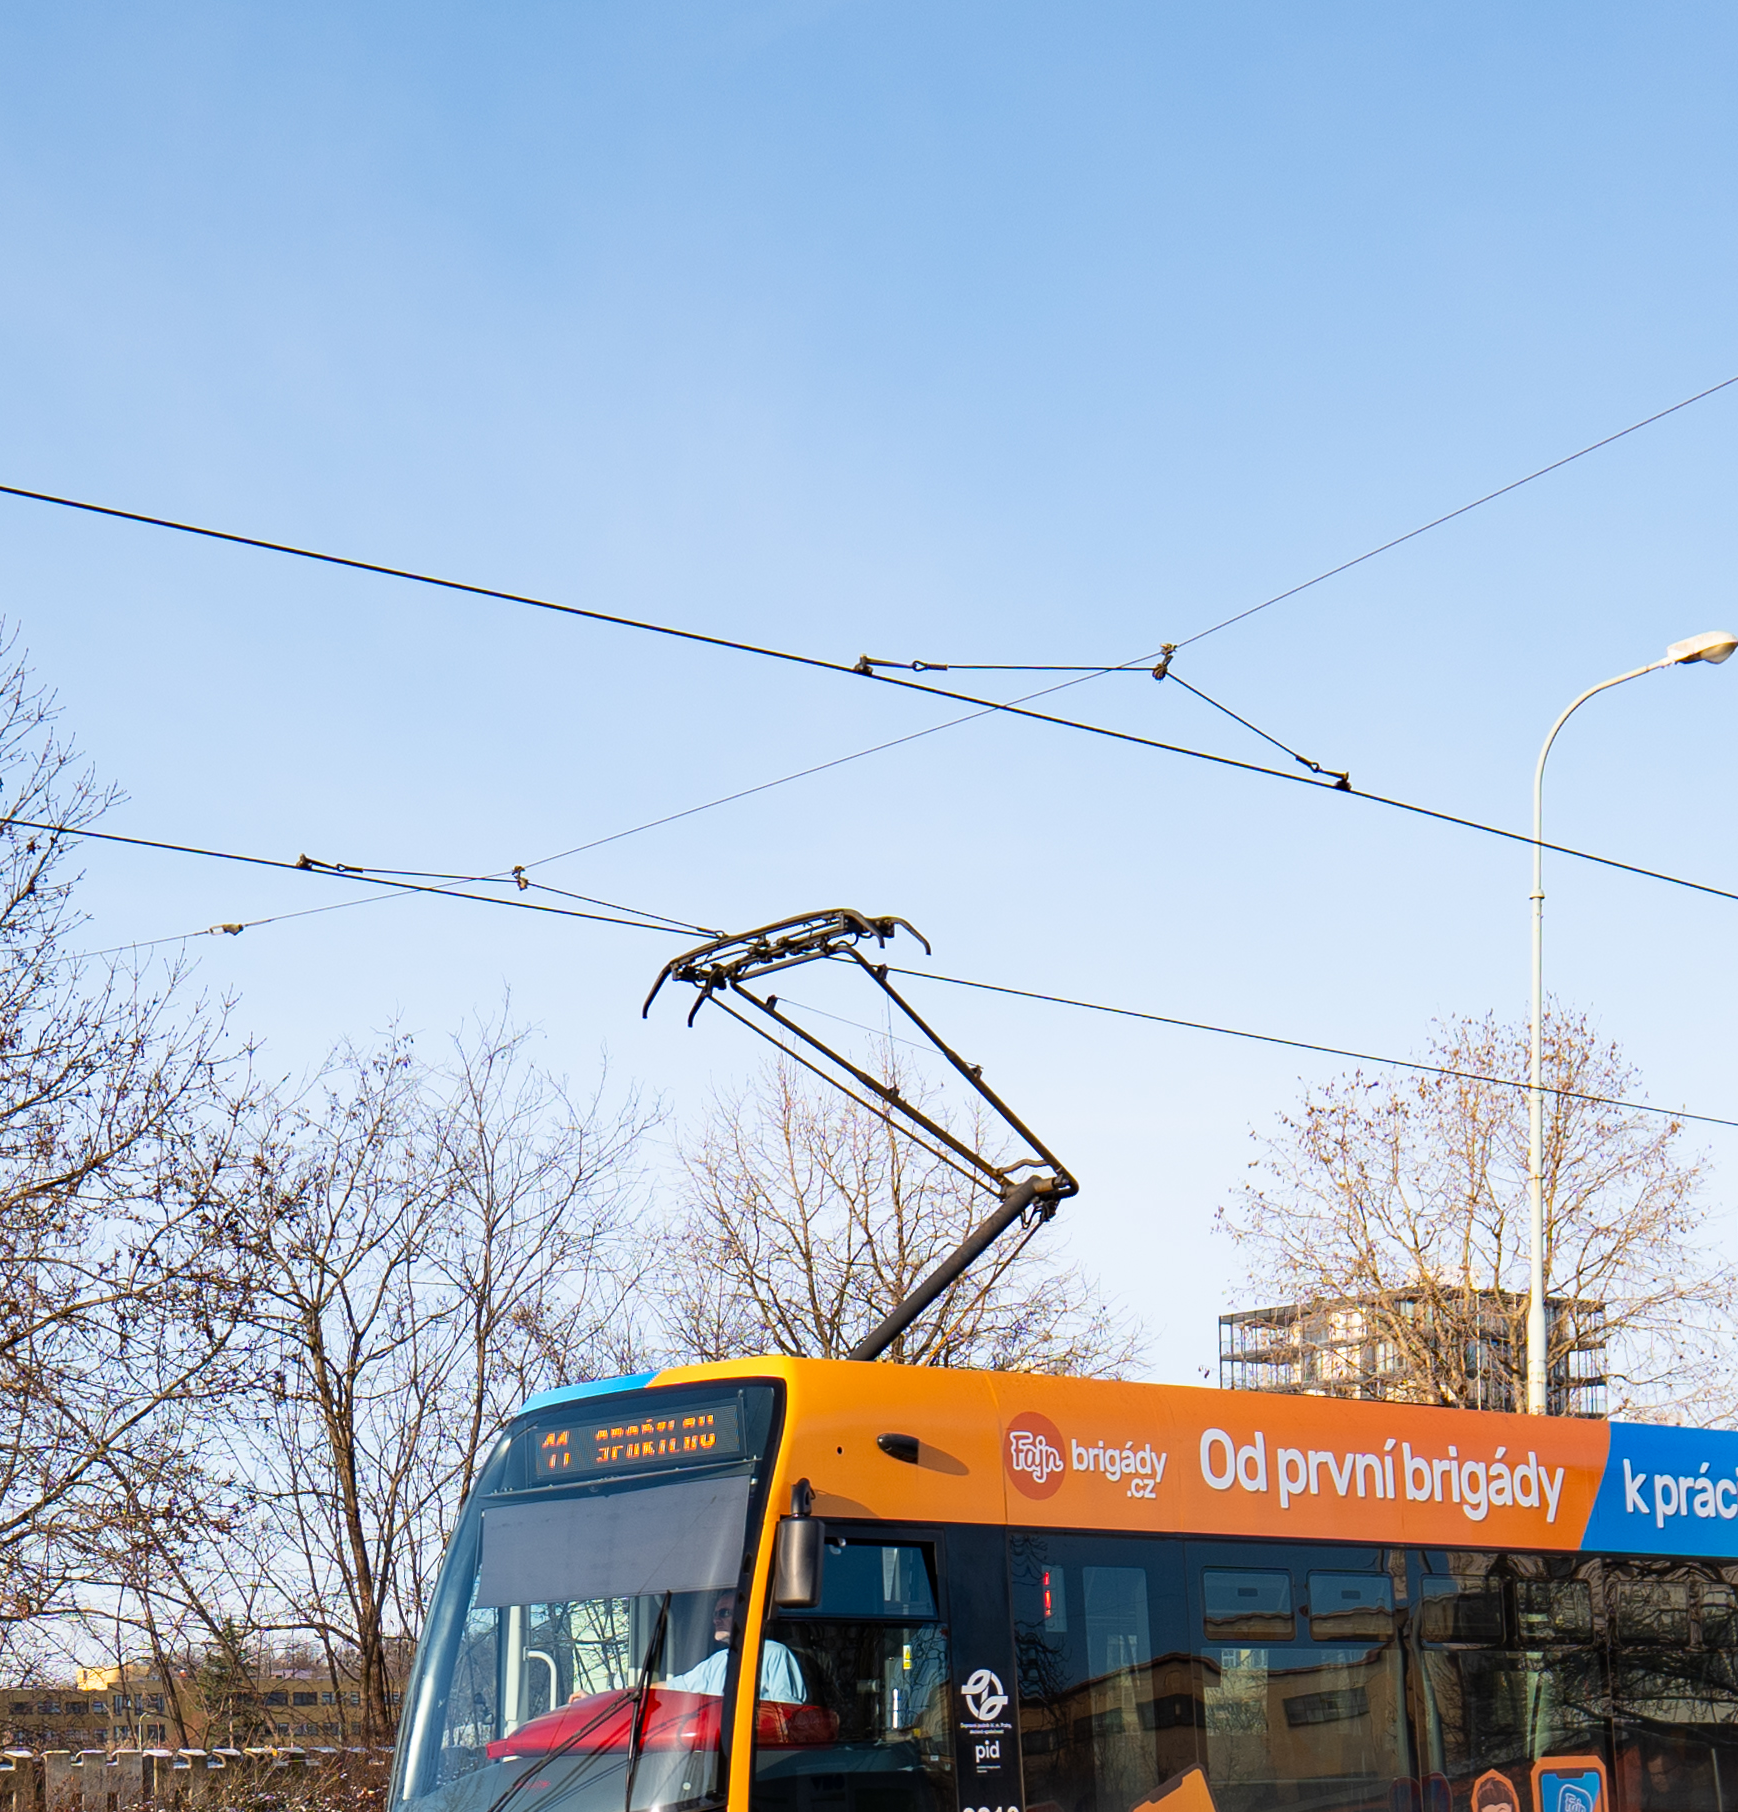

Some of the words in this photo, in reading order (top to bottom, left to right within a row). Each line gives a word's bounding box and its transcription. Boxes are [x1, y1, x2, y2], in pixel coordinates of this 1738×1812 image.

[1009, 1430, 1064, 1483] Fajn
[1071, 1438, 1167, 1483] brigády
[1199, 1427, 1267, 1492] Od
[1277, 1438, 1395, 1509] první
[1401, 1442, 1565, 1523] brigády
[1126, 1477, 1157, 1499] .cz
[1623, 1458, 1650, 1514] k
[975, 1740, 1000, 1763] pid
